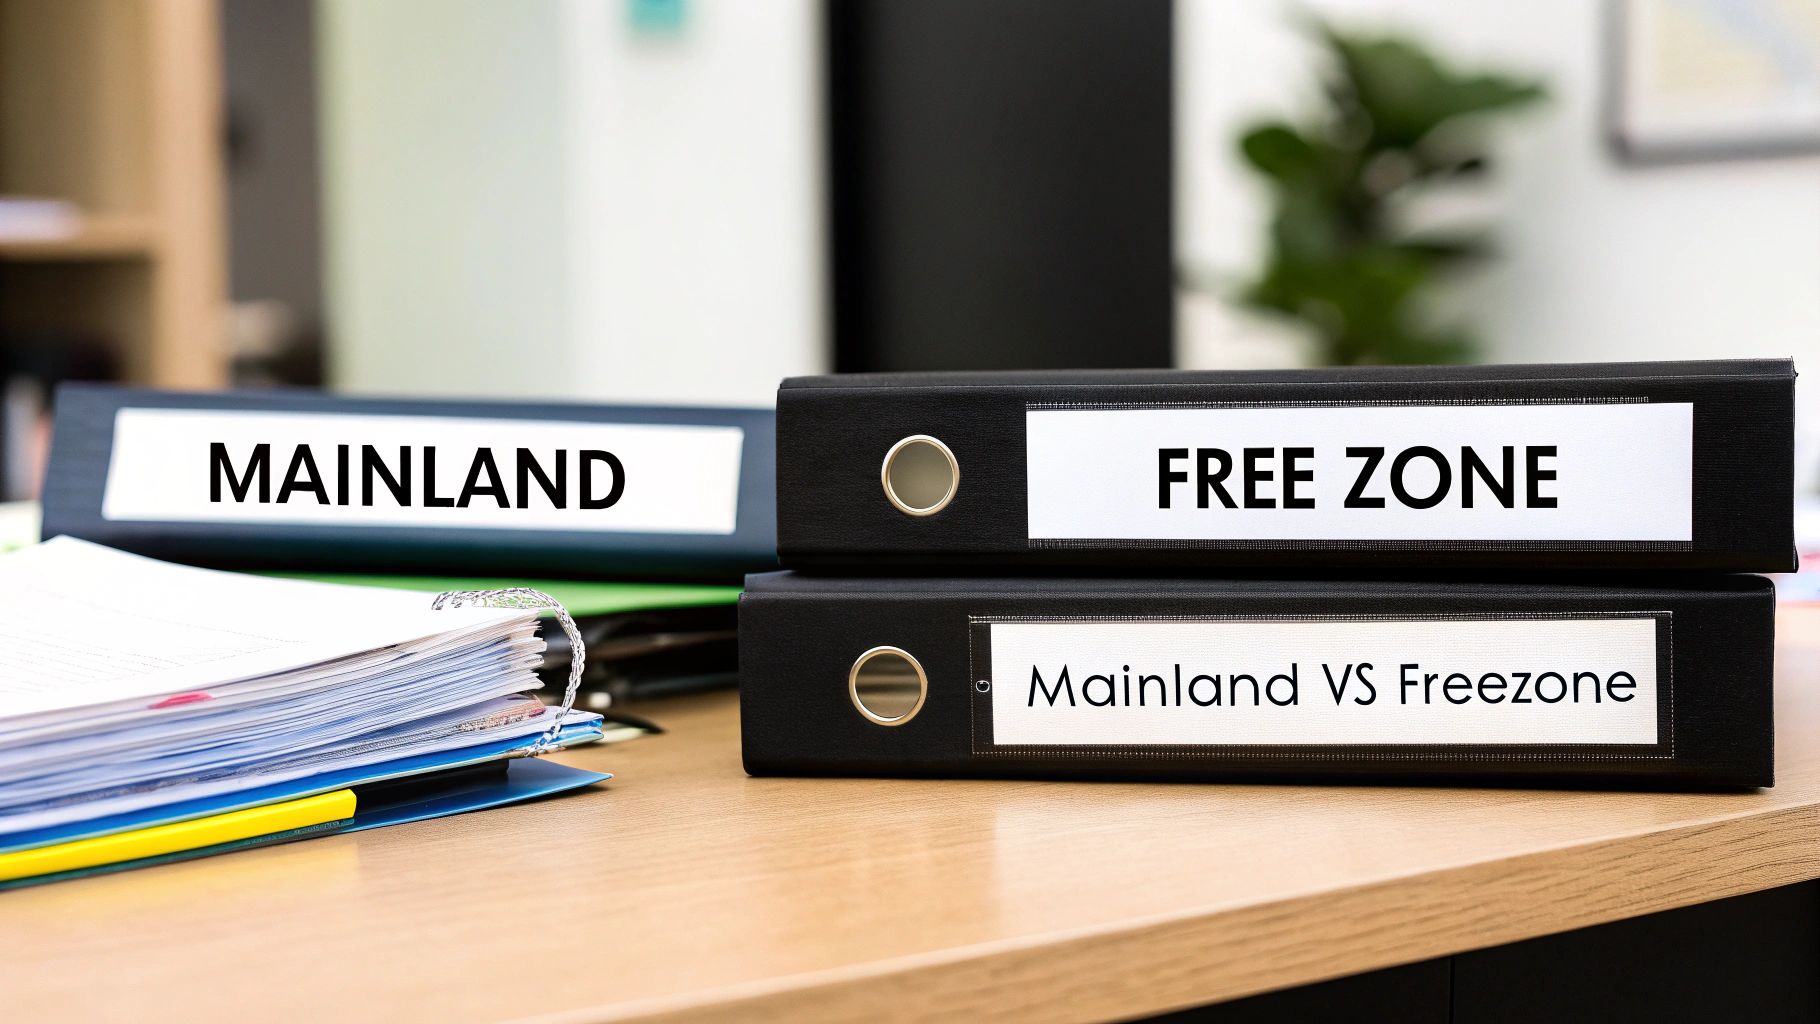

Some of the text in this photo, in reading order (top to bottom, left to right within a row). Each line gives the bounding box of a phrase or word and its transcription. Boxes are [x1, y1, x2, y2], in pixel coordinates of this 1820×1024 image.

[208, 442, 627, 510] MAINLAND
[1158, 445, 1558, 510] FREE ZONE
[1027, 661, 1637, 708] Mainland VS Freezone
